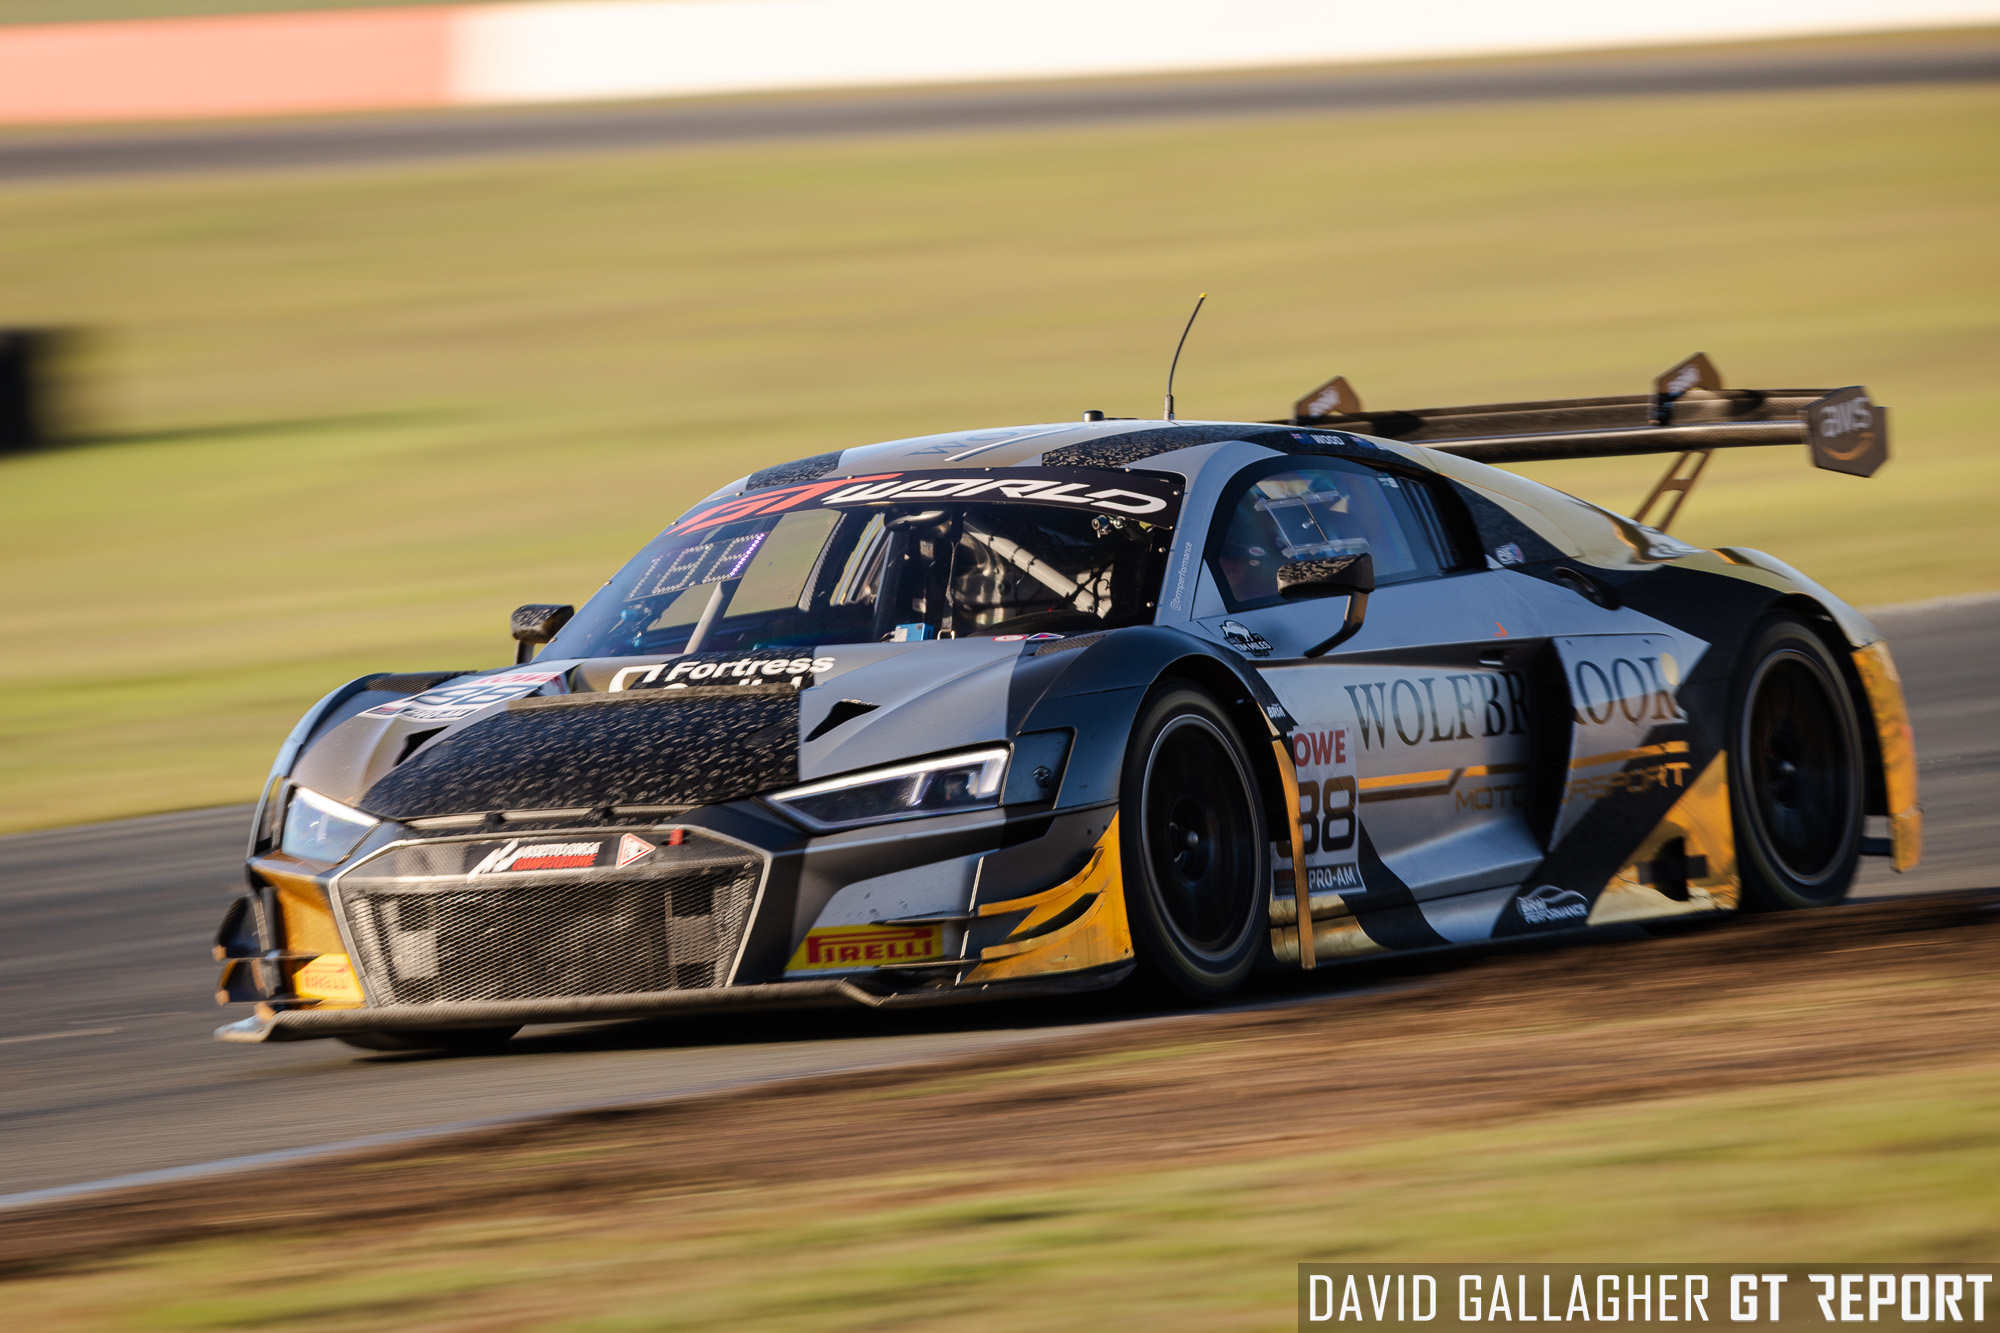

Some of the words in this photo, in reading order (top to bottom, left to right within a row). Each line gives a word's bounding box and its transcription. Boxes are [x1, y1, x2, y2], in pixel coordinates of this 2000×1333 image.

[1821, 396, 1873, 437] aws
[1310, 434, 1345, 446] WOOD
[666, 473, 904, 536] GT
[821, 479, 1168, 514] WORLD
[1170, 541, 1192, 612] @brmperformance
[664, 657, 836, 682] Fortress
[1292, 730, 1346, 767] OWE
[1308, 867, 1356, 889] PRO-AM
[807, 928, 933, 964] PIRELLI
